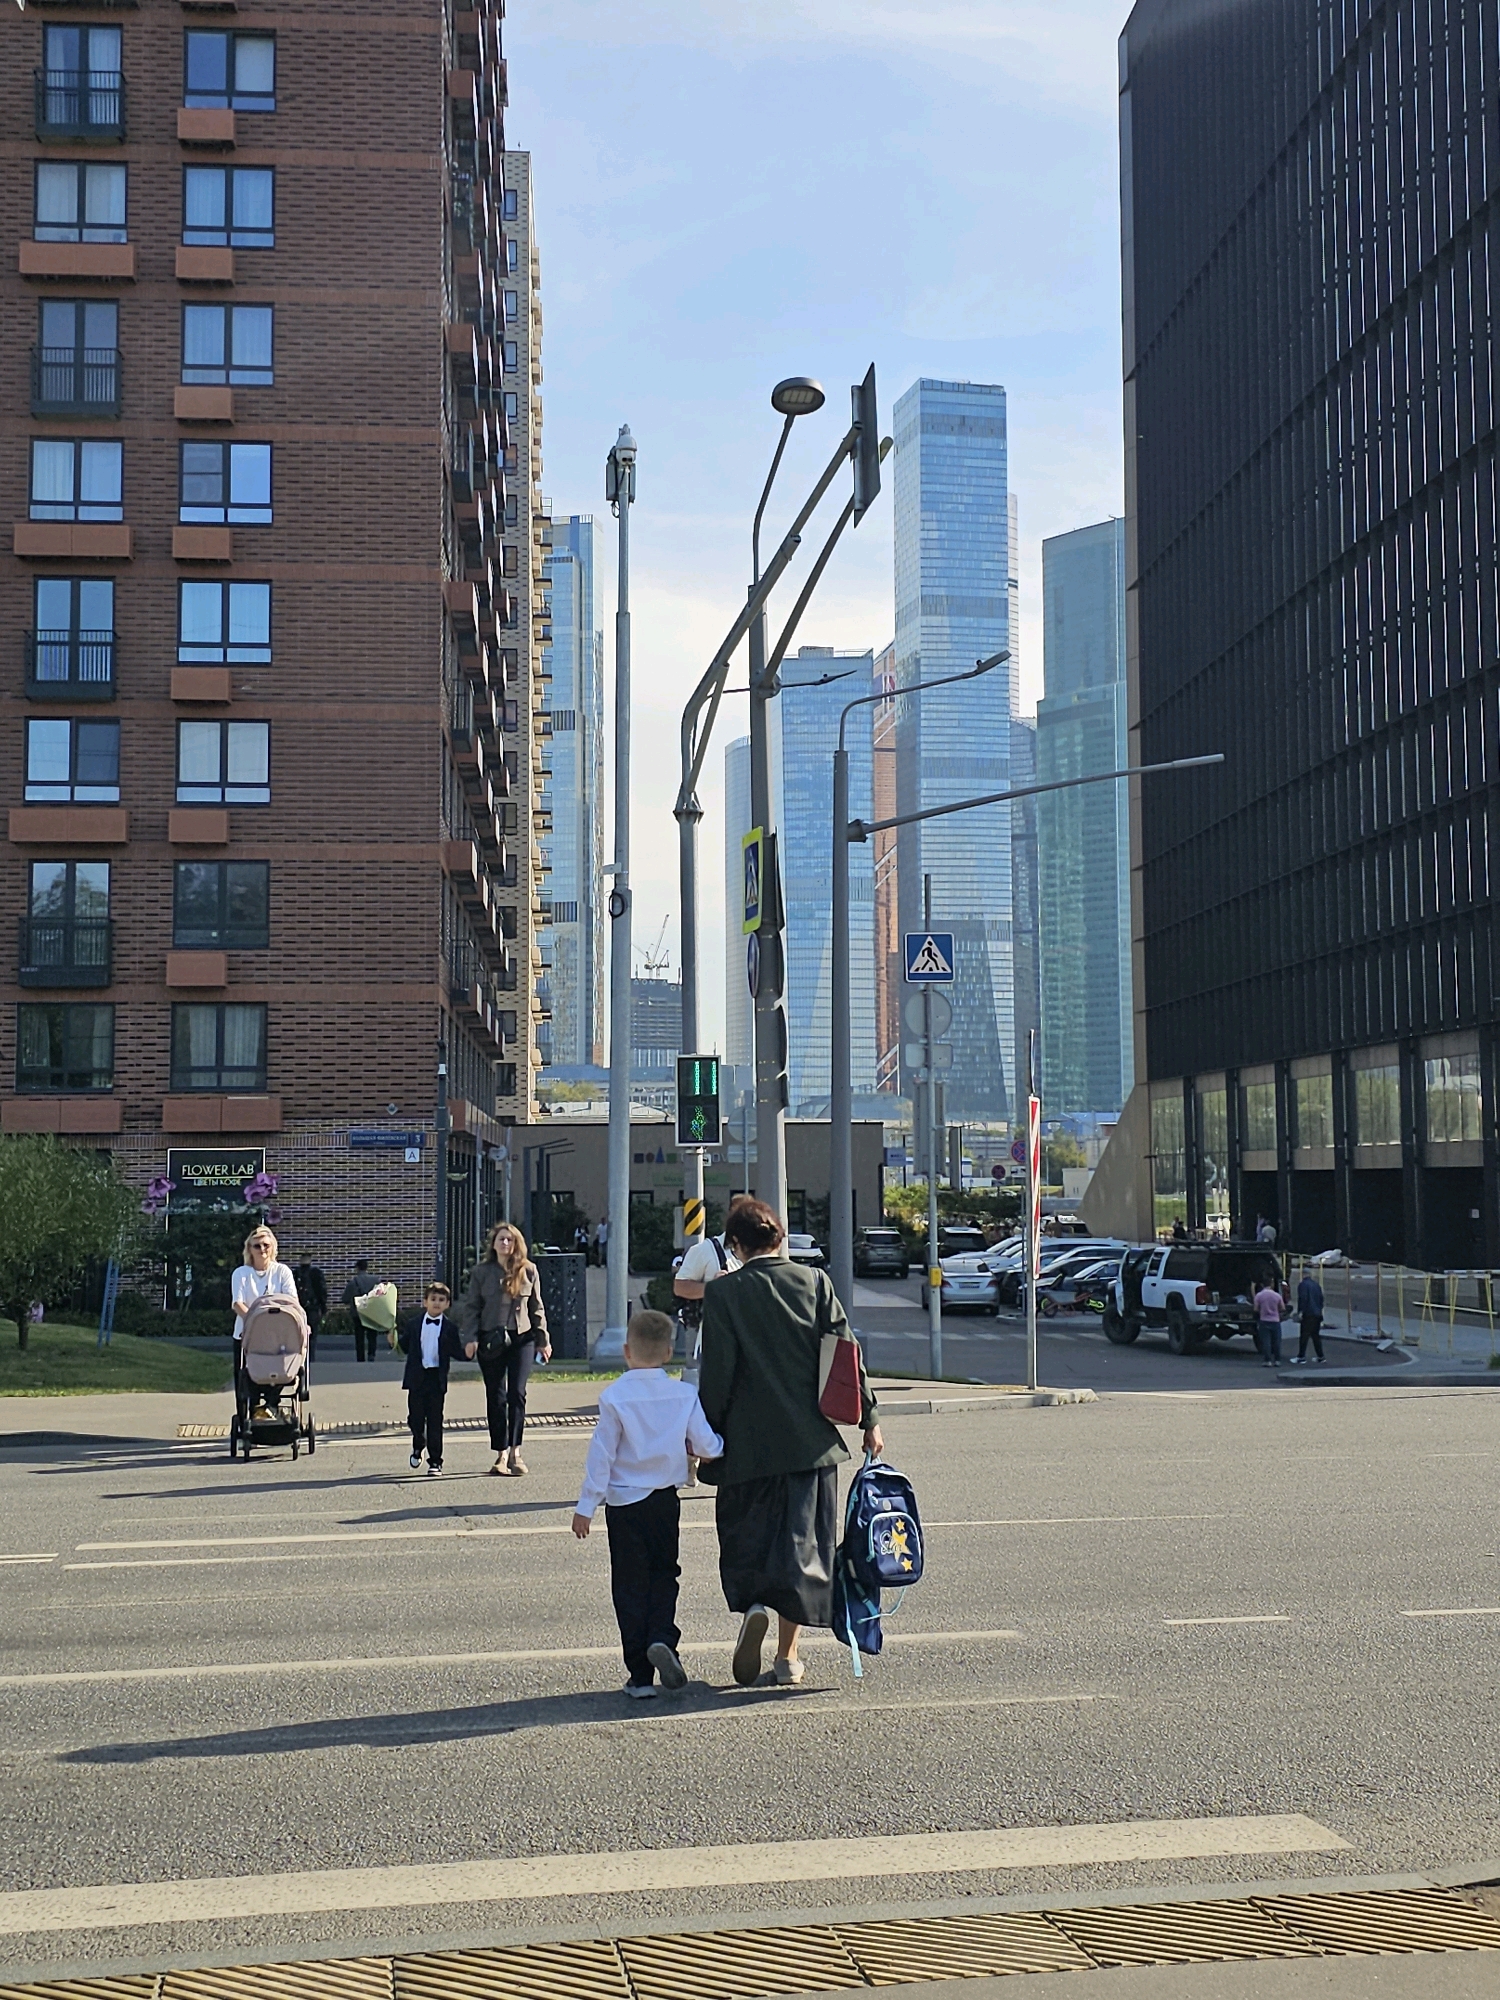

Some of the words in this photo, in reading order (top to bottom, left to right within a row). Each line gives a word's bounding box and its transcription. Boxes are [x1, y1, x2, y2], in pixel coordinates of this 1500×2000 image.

[415, 1134, 421, 1143] 3
[182, 1164, 229, 1176] FLOWER
[231, 1164, 254, 1175] LAB
